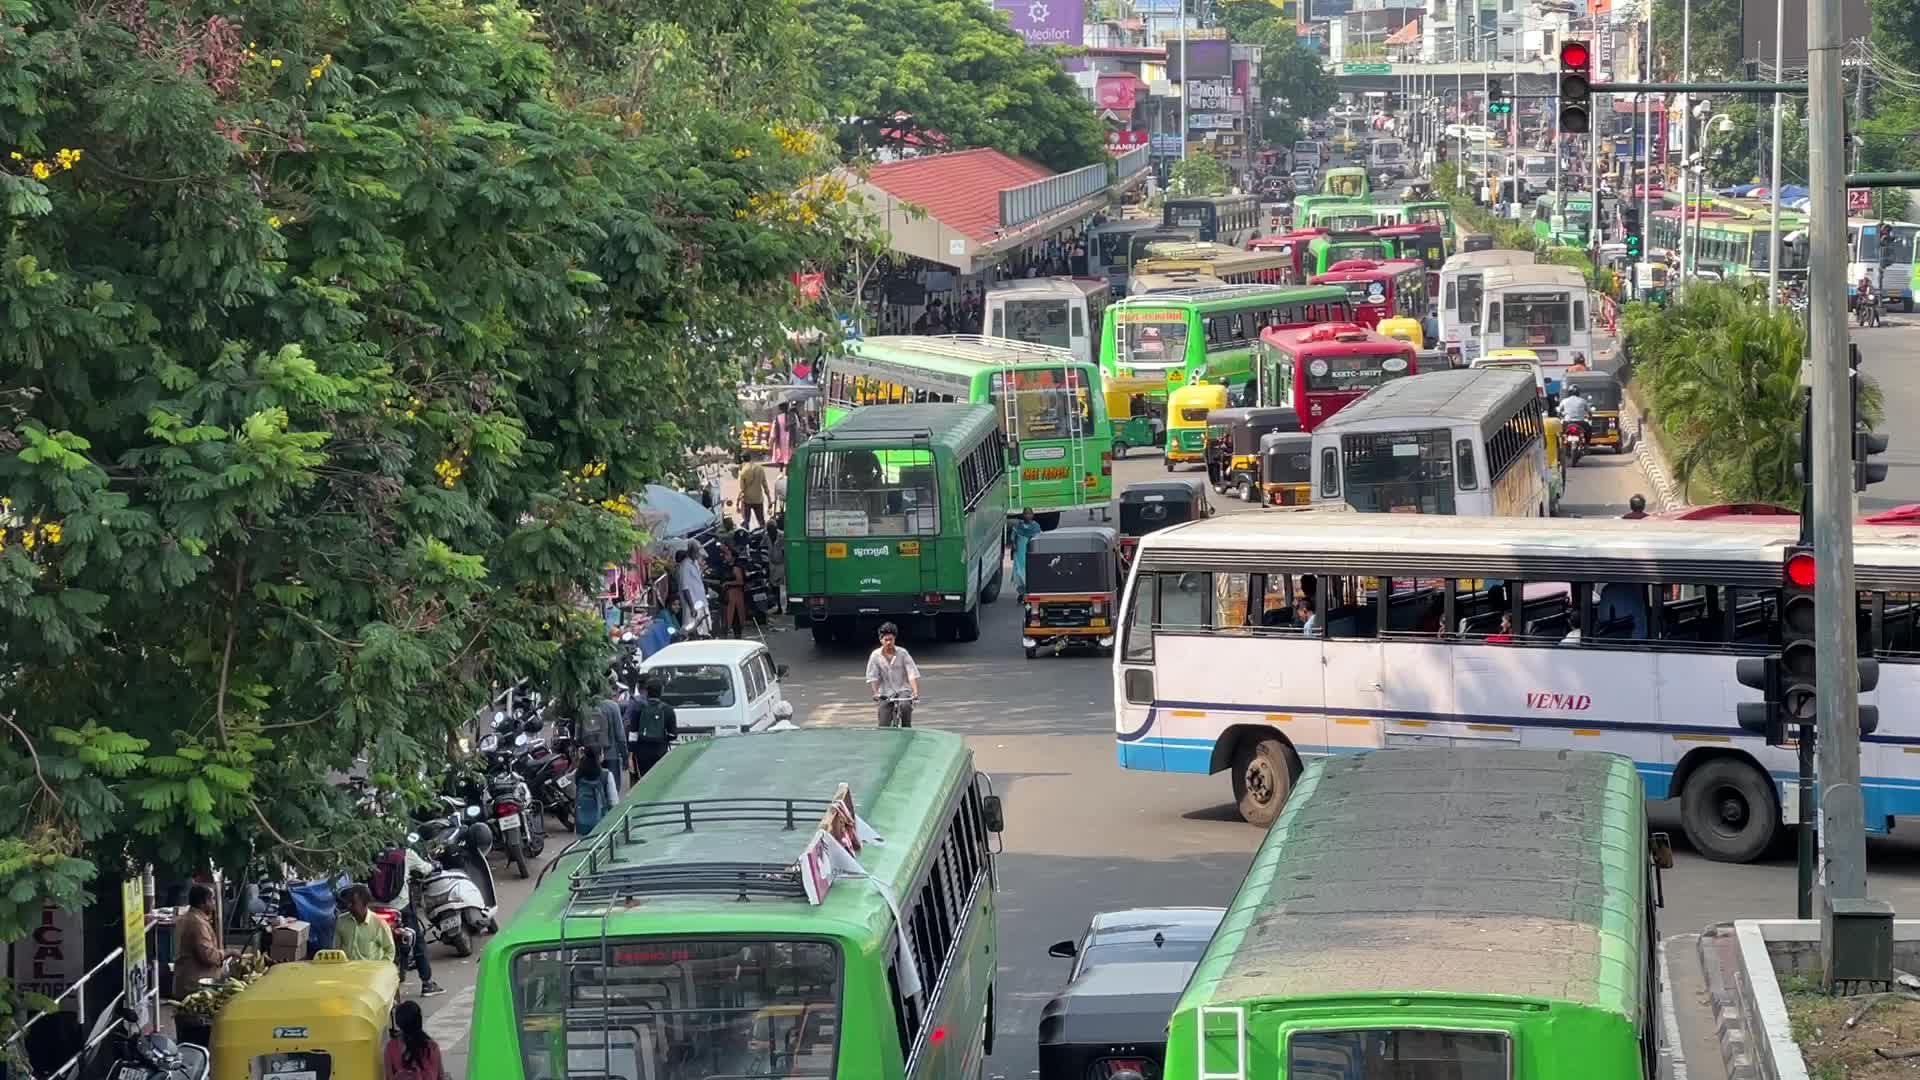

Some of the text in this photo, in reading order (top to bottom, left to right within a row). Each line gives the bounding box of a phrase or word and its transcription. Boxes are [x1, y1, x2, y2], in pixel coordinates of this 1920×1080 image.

[1025, 28, 1071, 40] Medifort
[1850, 191, 1868, 204] 24
[1526, 693, 1591, 710] VENAD
[33, 904, 65, 979] ICAL
[318, 952, 341, 961] TAXI
